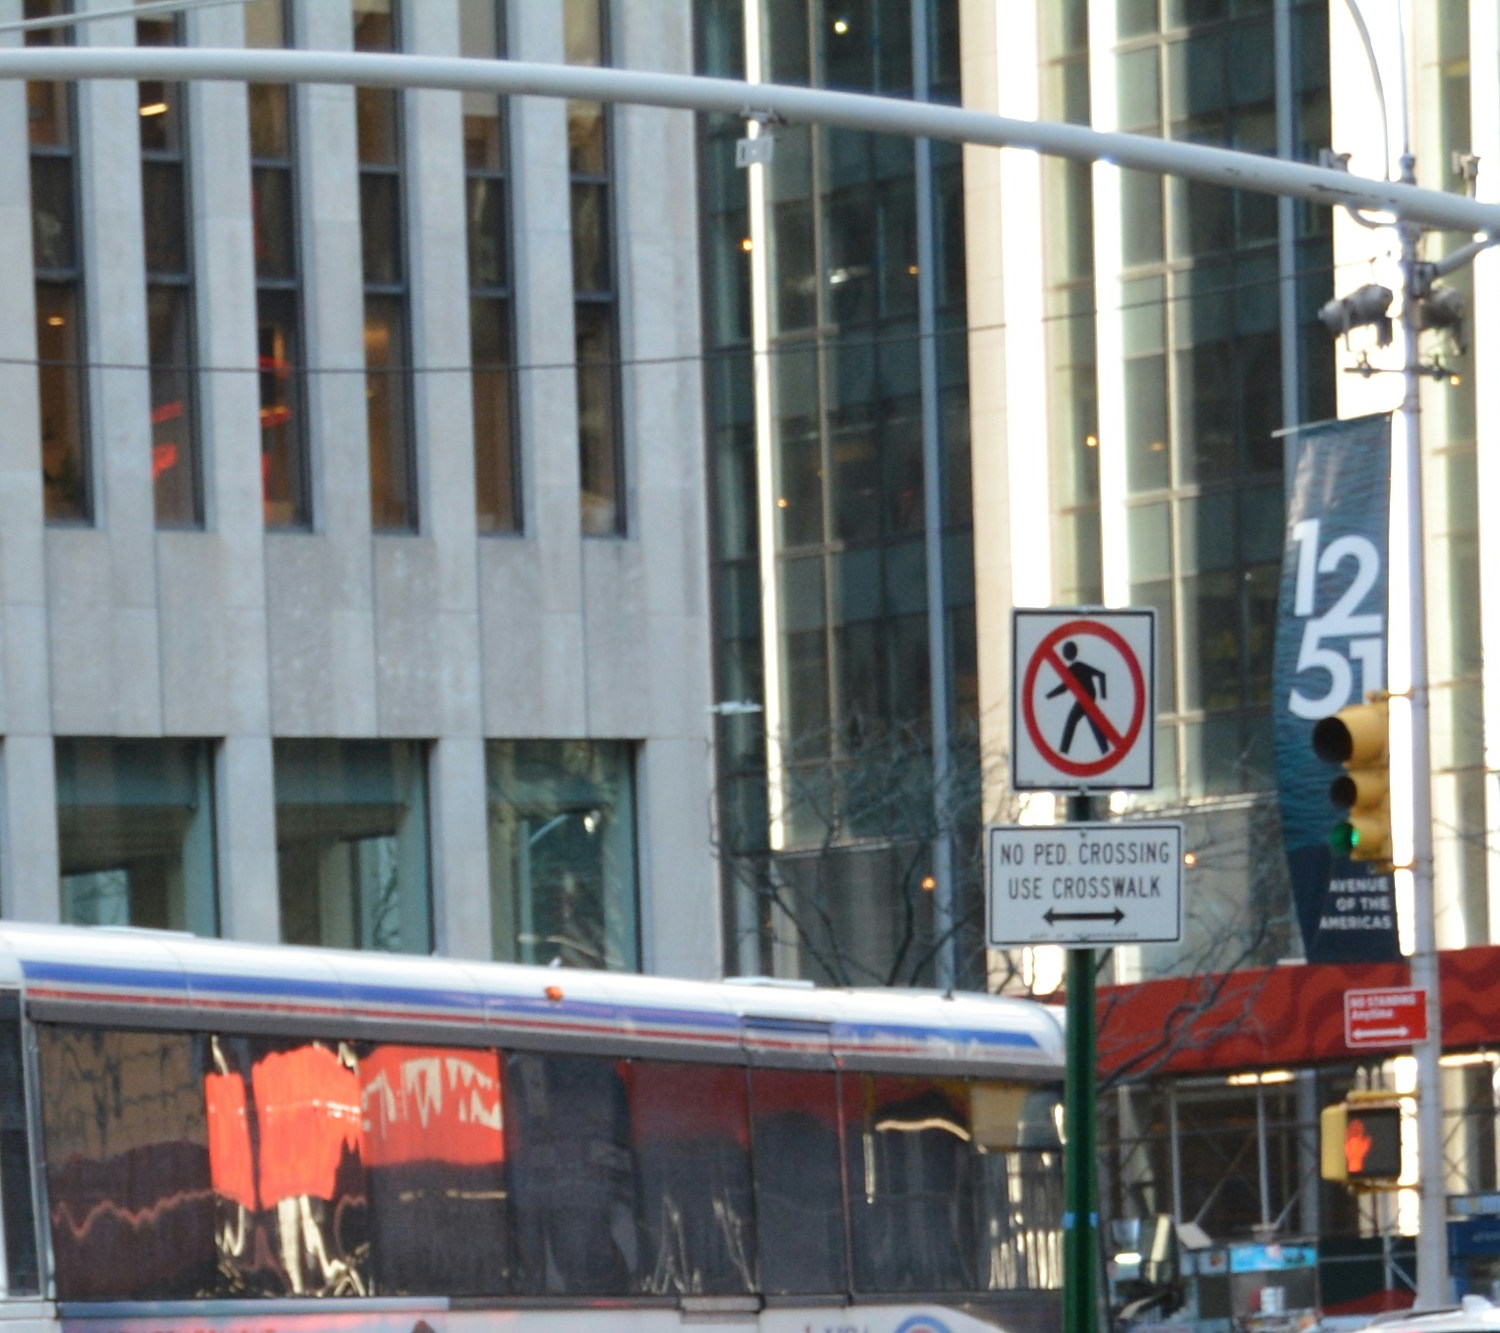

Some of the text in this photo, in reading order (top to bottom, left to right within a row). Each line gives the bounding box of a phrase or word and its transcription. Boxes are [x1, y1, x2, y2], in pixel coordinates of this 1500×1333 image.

[1001, 844, 1023, 865] NO
[1079, 842, 1169, 864] CROSSING
[1008, 877, 1161, 899] USE CROSSWALK
[1329, 877, 1388, 892] AVENUE
[1335, 896, 1390, 911] OF THE
[1319, 915, 1392, 930] AMERICAS
